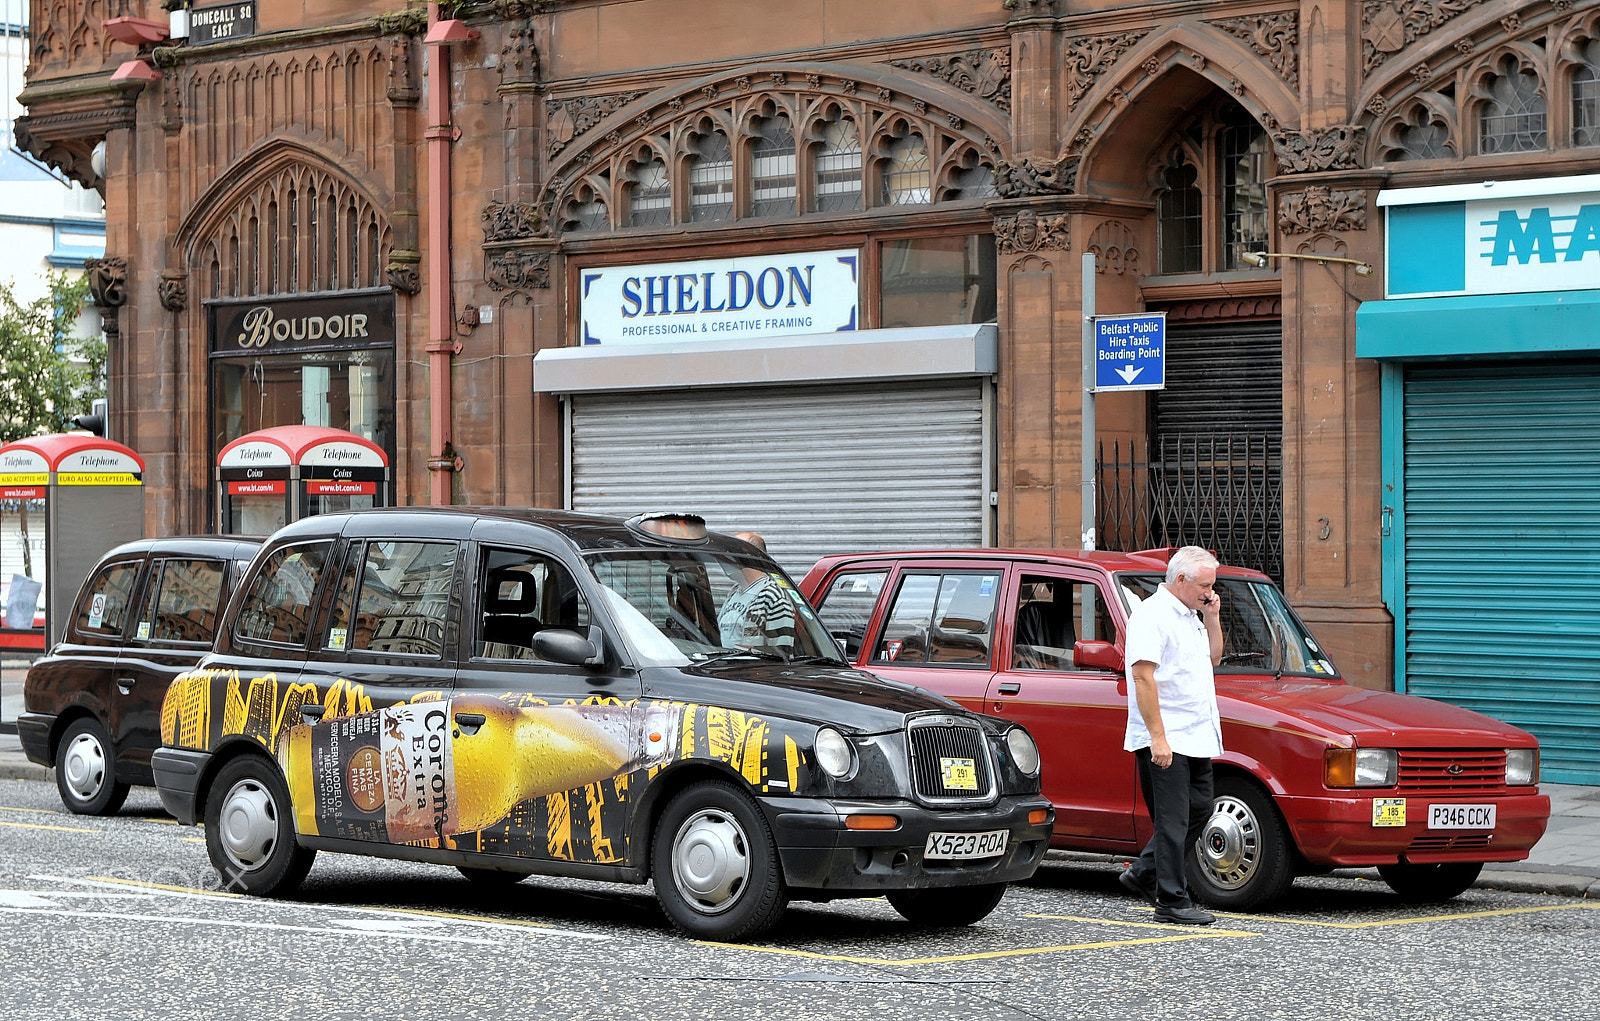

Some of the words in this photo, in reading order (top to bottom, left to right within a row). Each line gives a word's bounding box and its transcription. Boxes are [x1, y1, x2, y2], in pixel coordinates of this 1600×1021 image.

[240, 5, 252, 19] SQ
[211, 22, 234, 38] EAST
[620, 265, 815, 319] SHELDON
[238, 306, 369, 348] BOUDOIR
[622, 323, 697, 336] PROFESSIONAL
[701, 322, 707, 332] &
[711, 320, 761, 332] CREATIVE
[765, 316, 813, 329] FRAMING
[1101, 323, 1131, 335] Belfast
[1133, 321, 1159, 333] Public
[1109, 336, 1127, 347] Hire
[1128, 335, 1150, 346] Taxis
[1099, 348, 1136, 361] Boarding
[1138, 347, 1160, 359] Point
[240, 449, 273, 461] Telephone
[322, 448, 362, 461] Telephone
[4, 457, 33, 467] Telephone
[80, 456, 119, 468] Telephone
[246, 468, 263, 478] Coins
[333, 468, 353, 478] Coins
[330, 721, 339, 767] CERVECERIA
[373, 770, 380, 785] LA
[412, 734, 427, 810] Extra
[424, 710, 449, 832] Corona
[956, 768, 968, 778] 291
[359, 767, 367, 792] MAS
[365, 752, 375, 805] CERVEZA
[1387, 807, 1399, 817] 185
[1433, 808, 1465, 825] P346
[1467, 808, 1492, 825] CCK
[927, 834, 977, 855] X523
[977, 832, 1005, 854] ROA
